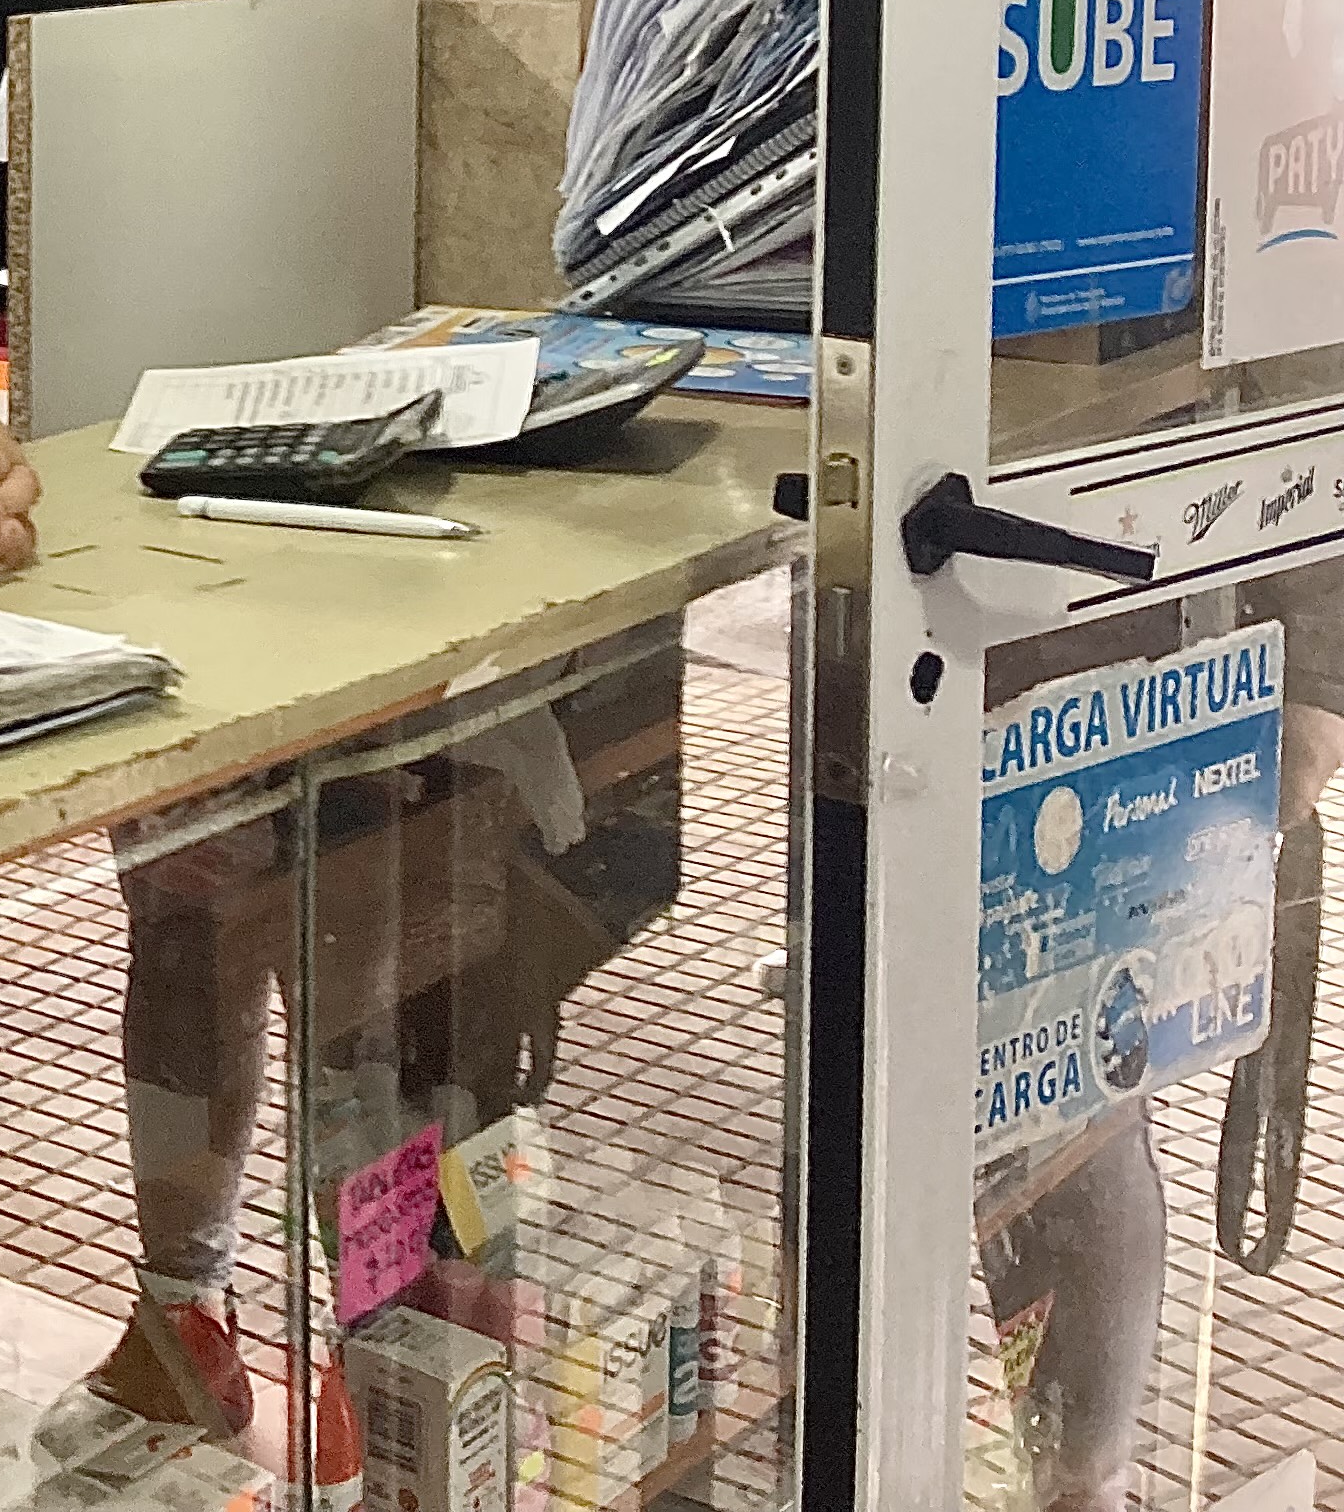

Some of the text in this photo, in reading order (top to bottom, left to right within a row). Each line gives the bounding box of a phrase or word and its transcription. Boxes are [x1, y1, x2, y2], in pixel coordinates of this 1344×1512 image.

[1267, 119, 1344, 195] PATY
[1257, 467, 1315, 532] Imperial
[1120, 643, 1275, 739] VIRTUAL
[1193, 752, 1262, 799] NEXTEL
[979, 1013, 1082, 1077] ENTRO DE
[974, 1052, 1082, 1135] ARGA
